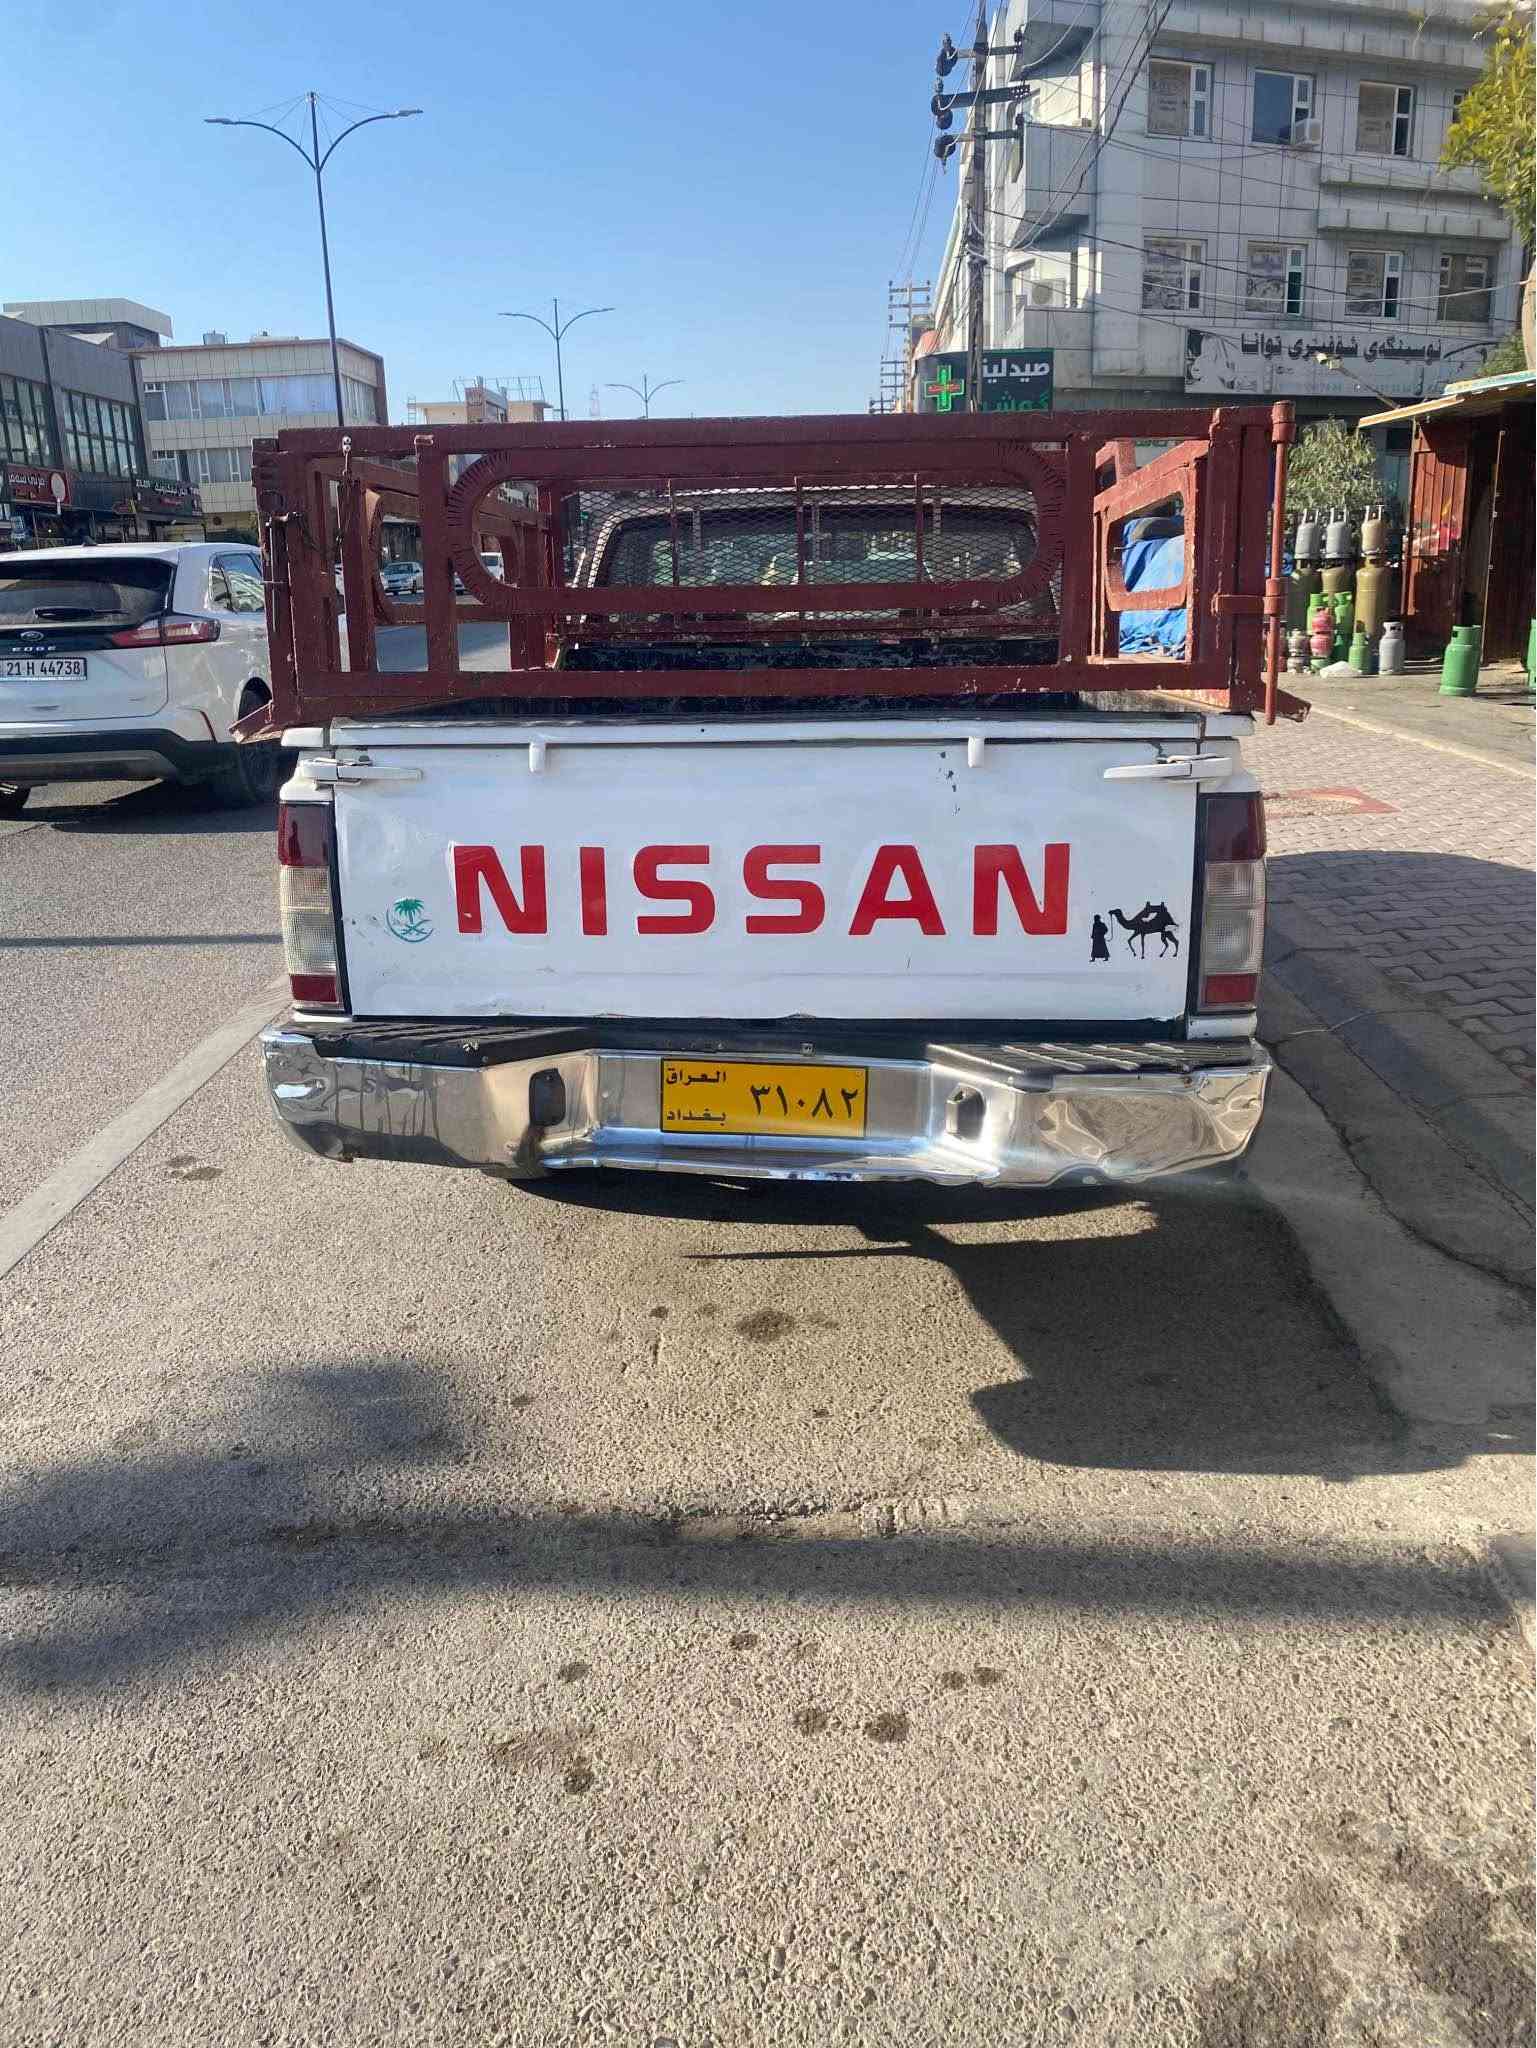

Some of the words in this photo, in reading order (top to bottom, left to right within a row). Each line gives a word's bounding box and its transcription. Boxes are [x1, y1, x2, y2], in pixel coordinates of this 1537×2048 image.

[6, 662, 21, 675] 21
[27, 662, 35, 675] H
[40, 661, 81, 675] 44738
[454, 843, 1071, 935] NISSAN
[666, 1067, 727, 1086] العراق
[750, 1084, 858, 1119] ٣١٠٨٢
[666, 1107, 726, 1126] بغداد
